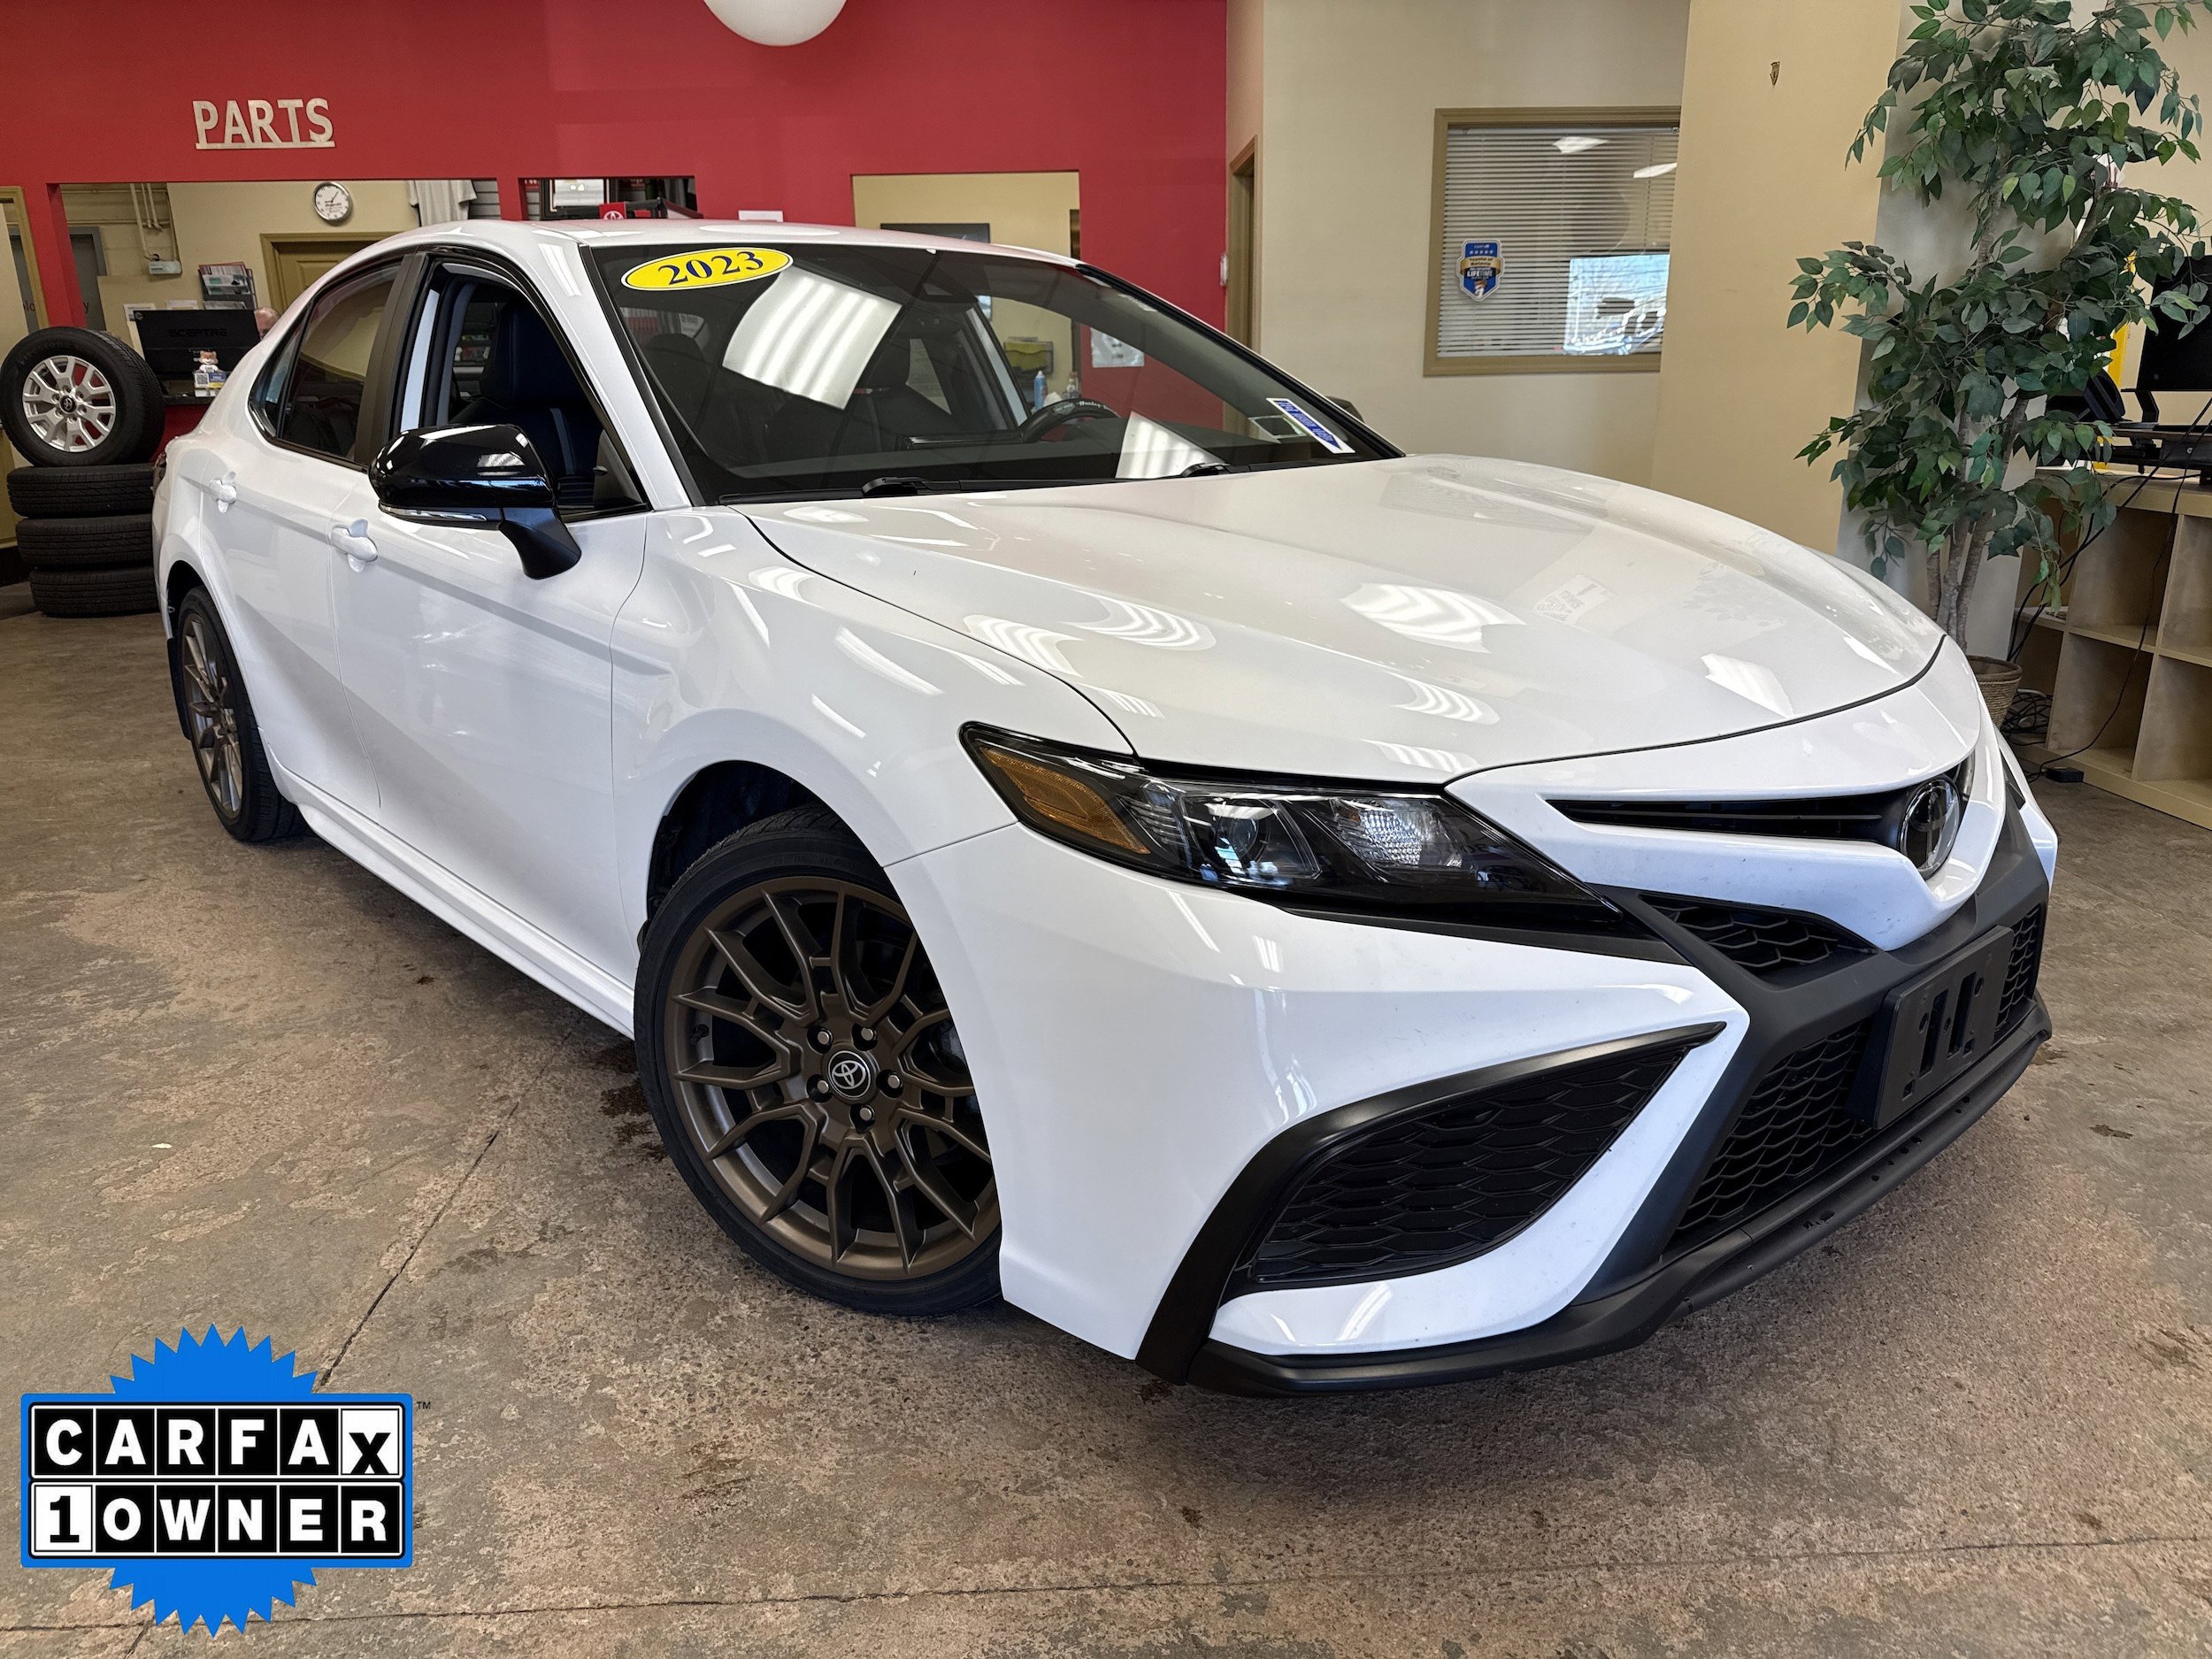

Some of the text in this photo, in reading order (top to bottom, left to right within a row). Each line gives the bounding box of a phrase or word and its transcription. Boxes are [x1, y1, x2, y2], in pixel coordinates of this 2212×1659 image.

[192, 97, 335, 147] PARTS
[657, 250, 764, 286] 2023
[168, 327, 228, 338] SCEPTRE
